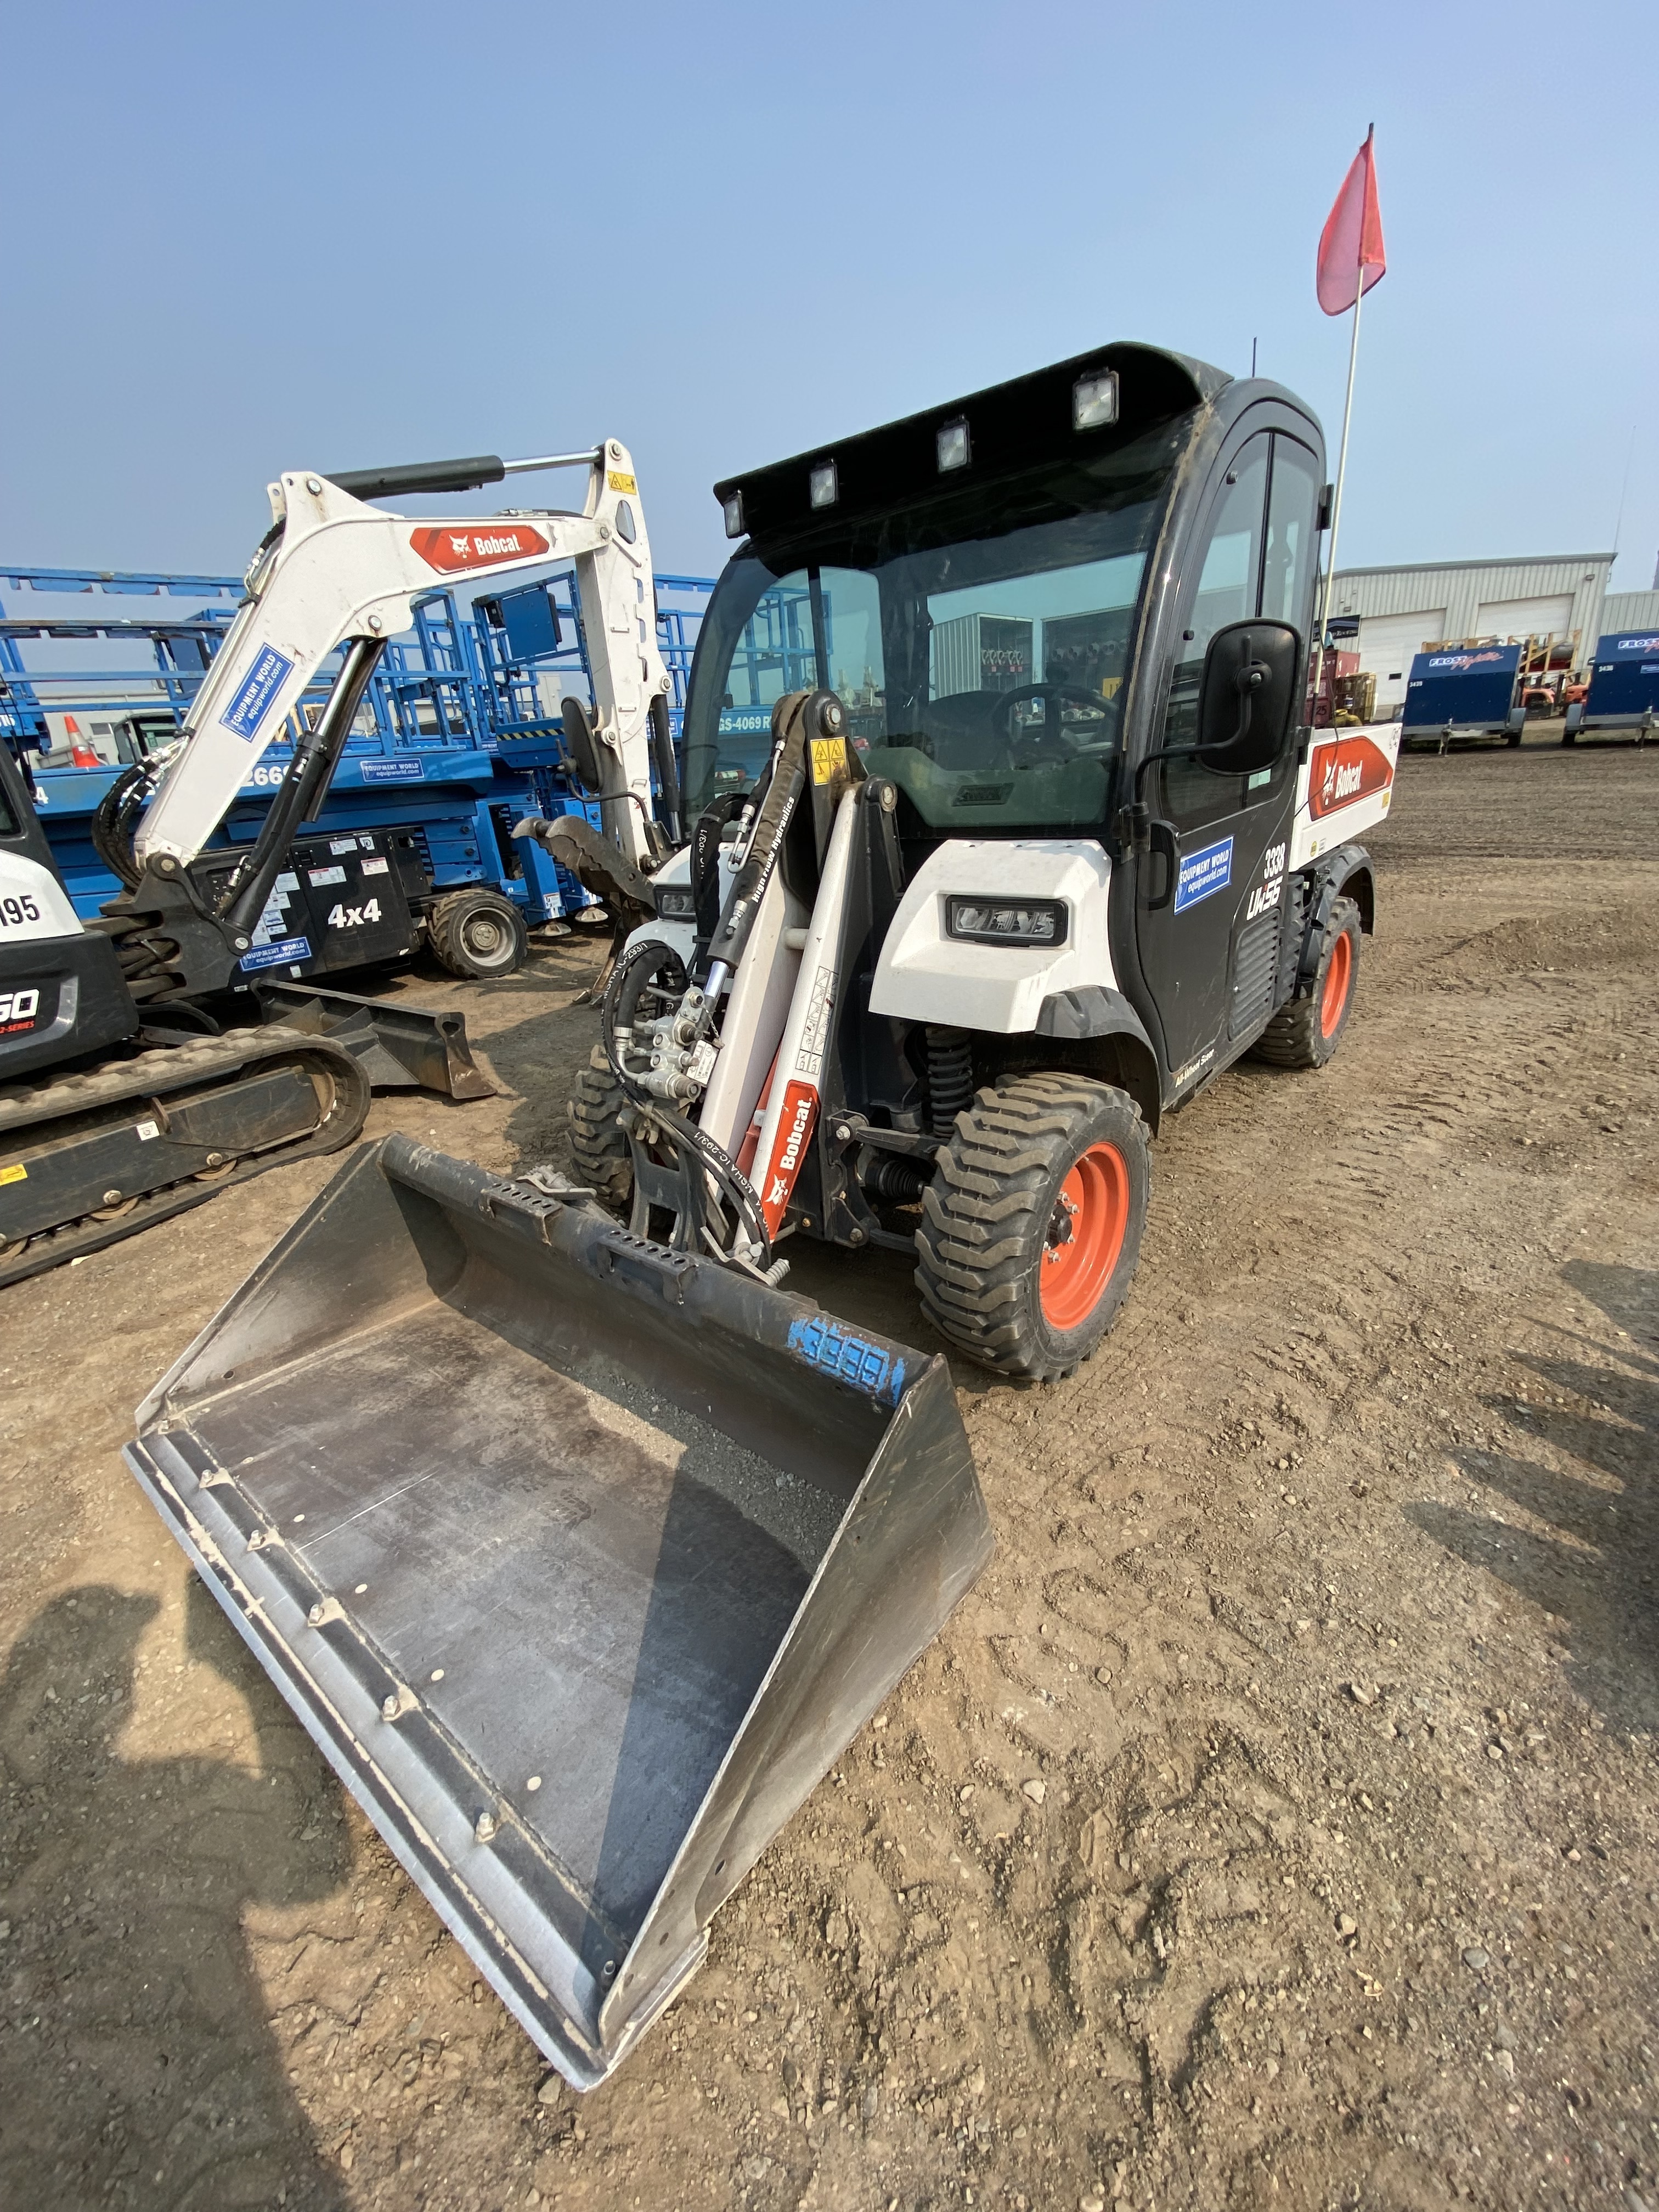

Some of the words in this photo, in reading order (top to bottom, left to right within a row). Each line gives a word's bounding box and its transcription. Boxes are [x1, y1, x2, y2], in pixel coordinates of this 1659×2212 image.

[473, 534, 521, 555] Bobcat
[231, 682, 261, 727] EQUIPMENT
[255, 654, 276, 682] WORLD
[248, 661, 284, 720] equipworld.com
[719, 716, 761, 731] GS-4069
[763, 715, 772, 729] R
[1335, 760, 1363, 799] Bobcat
[752, 876, 766, 903] High
[771, 796, 795, 850] Hydraulics
[1180, 858, 1211, 884] EQUIPMENT
[1211, 849, 1229, 868] WORLD
[1263, 842, 1286, 879] 3338
[1187, 865, 1227, 894] equipworld.com
[328, 898, 382, 928] 4x4
[1246, 876, 1283, 921] UW56
[256, 949, 305, 963] equipworld.com
[281, 943, 304, 951] WORLD
[780, 1099, 811, 1170] Bobcat
